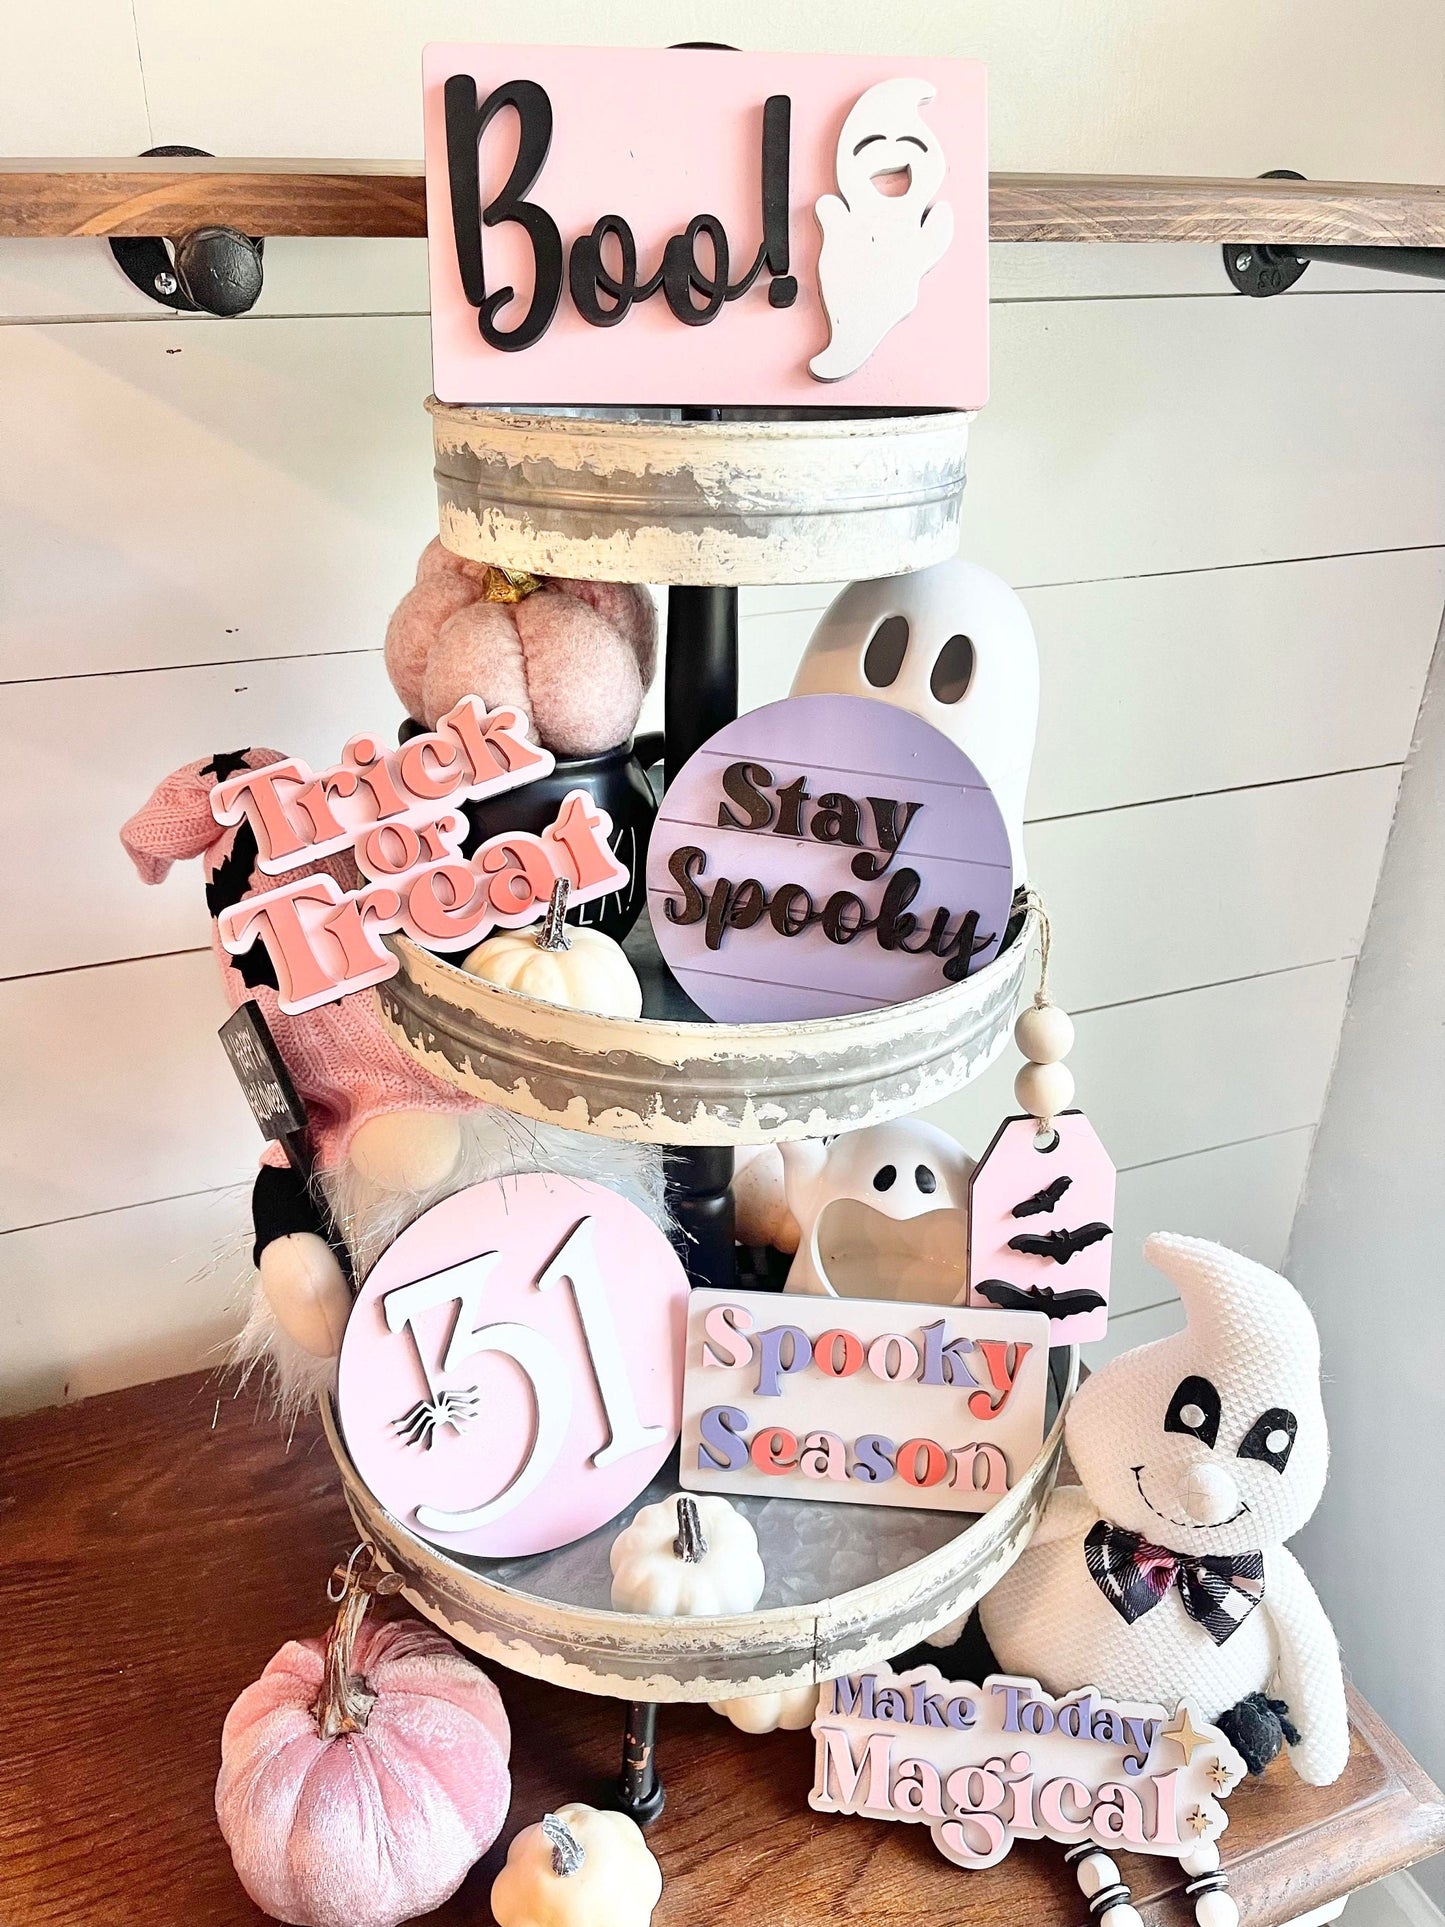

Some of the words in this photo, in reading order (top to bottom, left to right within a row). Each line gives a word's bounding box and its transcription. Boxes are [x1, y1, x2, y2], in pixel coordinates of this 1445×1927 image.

[444, 74, 798, 352] Boo!
[220, 700, 544, 861] Trick
[365, 815, 455, 874] or
[717, 761, 924, 881] Stay
[230, 797, 618, 1003] Treat
[664, 845, 997, 982] Spooky
[382, 1215, 668, 1533] 31
[702, 1302, 1033, 1421] Spooky
[697, 1405, 1010, 1494] Season
[829, 1674, 976, 1730] Make
[990, 1683, 1163, 1775] Today
[816, 1726, 1182, 1859] Magical
